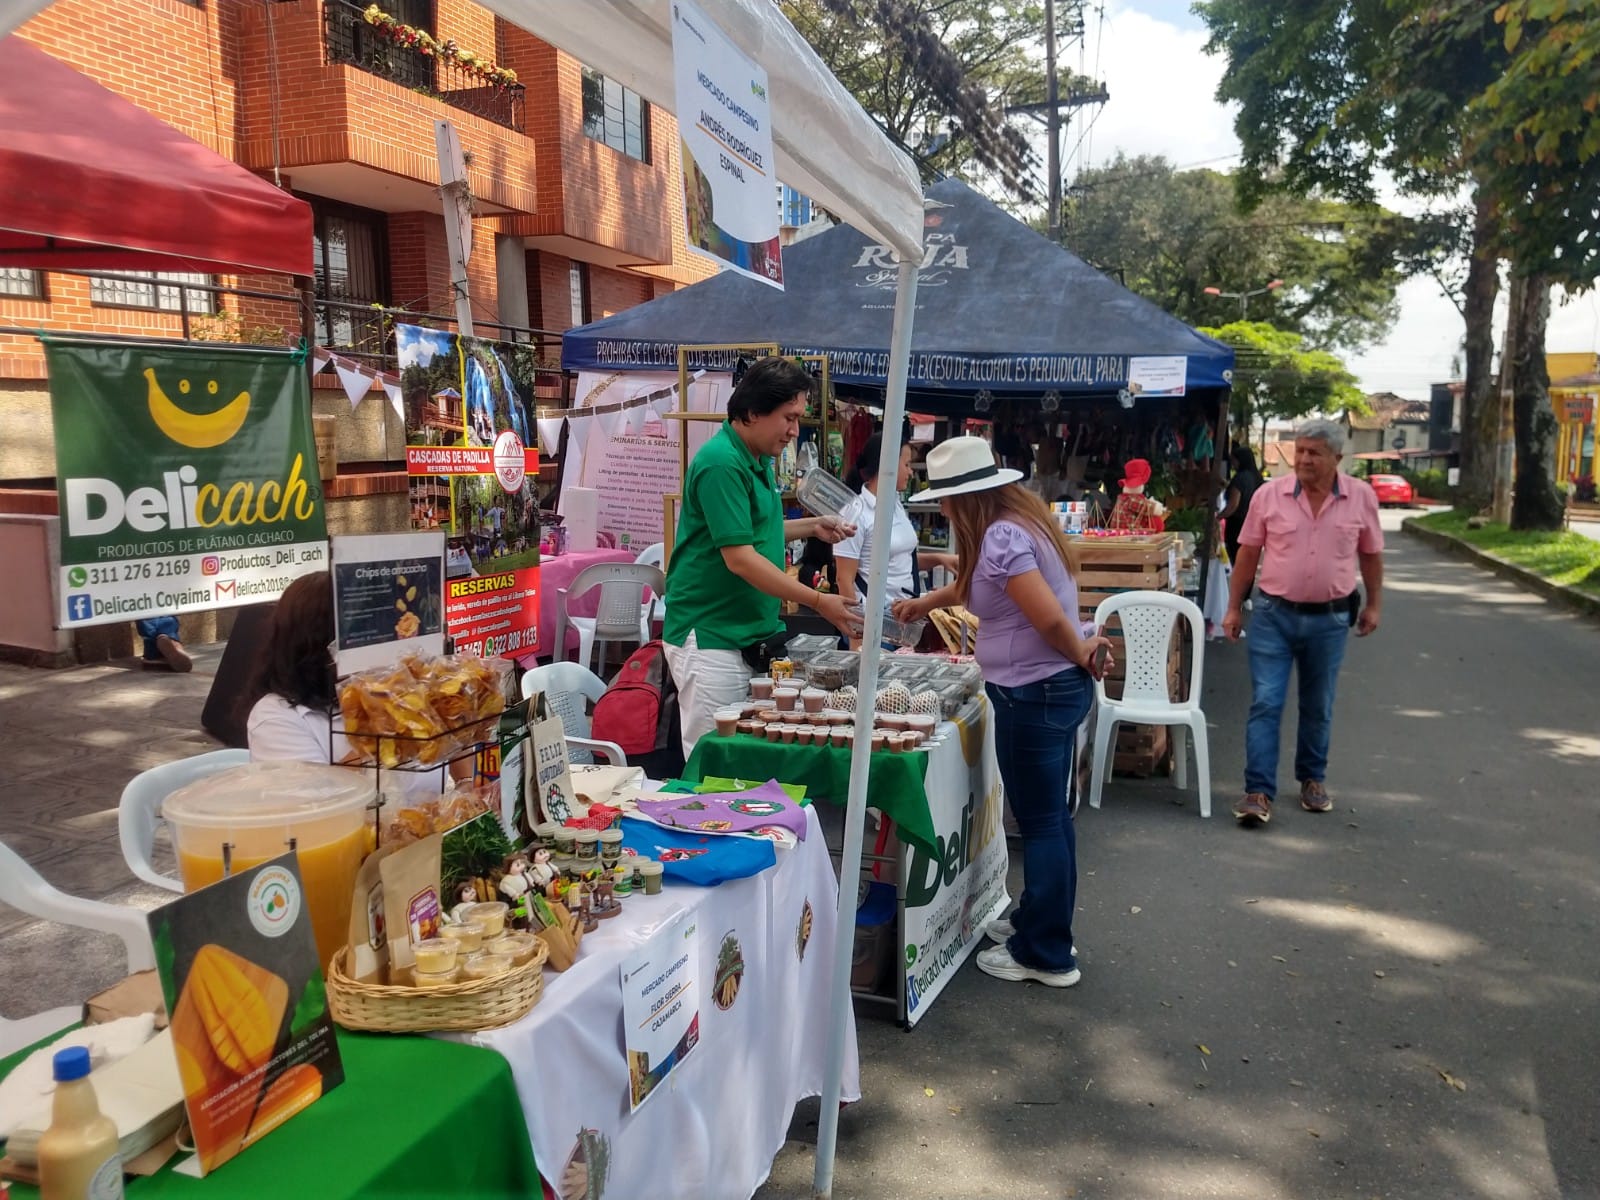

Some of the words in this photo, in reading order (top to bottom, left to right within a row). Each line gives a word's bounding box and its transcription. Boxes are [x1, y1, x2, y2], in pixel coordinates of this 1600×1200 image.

[697, 69, 726, 105] MERCADO
[726, 97, 759, 132] CAMPESINO
[700, 110, 726, 142] ANDRÉS
[727, 131, 763, 169] RODRÍGUEZ
[719, 153, 746, 183] ESPINAL
[852, 243, 970, 269] RJA
[596, 340, 641, 364] PROHIBASE
[643, 342, 653, 365] EL
[654, 343, 694, 367] EXPENO
[695, 348, 706, 367] DE
[708, 347, 740, 369] BEBIDA
[862, 354, 875, 377] DE
[918, 355, 953, 380] EXCESO
[954, 357, 969, 380] DE
[968, 358, 1013, 382] ALCOHOL
[1014, 357, 1028, 382] ES
[1096, 357, 1123, 382] PARA
[409, 450, 451, 464] CASCADAS
[452, 451, 462, 464] DE
[463, 451, 490, 464] PADILLA
[65, 452, 314, 537] Delicach
[98, 541, 175, 558] PRODUCTOS
[180, 539, 194, 552] DE
[196, 534, 244, 551] PLÁTANO
[247, 530, 294, 545] CACHACO
[90, 567, 119, 585] 311
[124, 562, 151, 581] 276
[156, 559, 191, 577] 2169
[355, 567, 380, 580] Chips
[380, 566, 391, 577] de
[450, 574, 516, 598] RESERVAS
[93, 593, 152, 616] Delicach
[156, 588, 211, 610] Coyaima
[237, 576, 295, 597] delicach2018@
[540, 742, 563, 763] FELIZ
[641, 974, 665, 998] MERCADO
[665, 953, 689, 979] CAMPESINO
[650, 997, 665, 1015] FLOR
[664, 981, 682, 1003] SIERRA
[651, 1000, 682, 1032] CAJAMARCA
[200, 1082, 239, 1111] ASOCIACIÓN
[308, 1025, 329, 1042] TOLIMA
